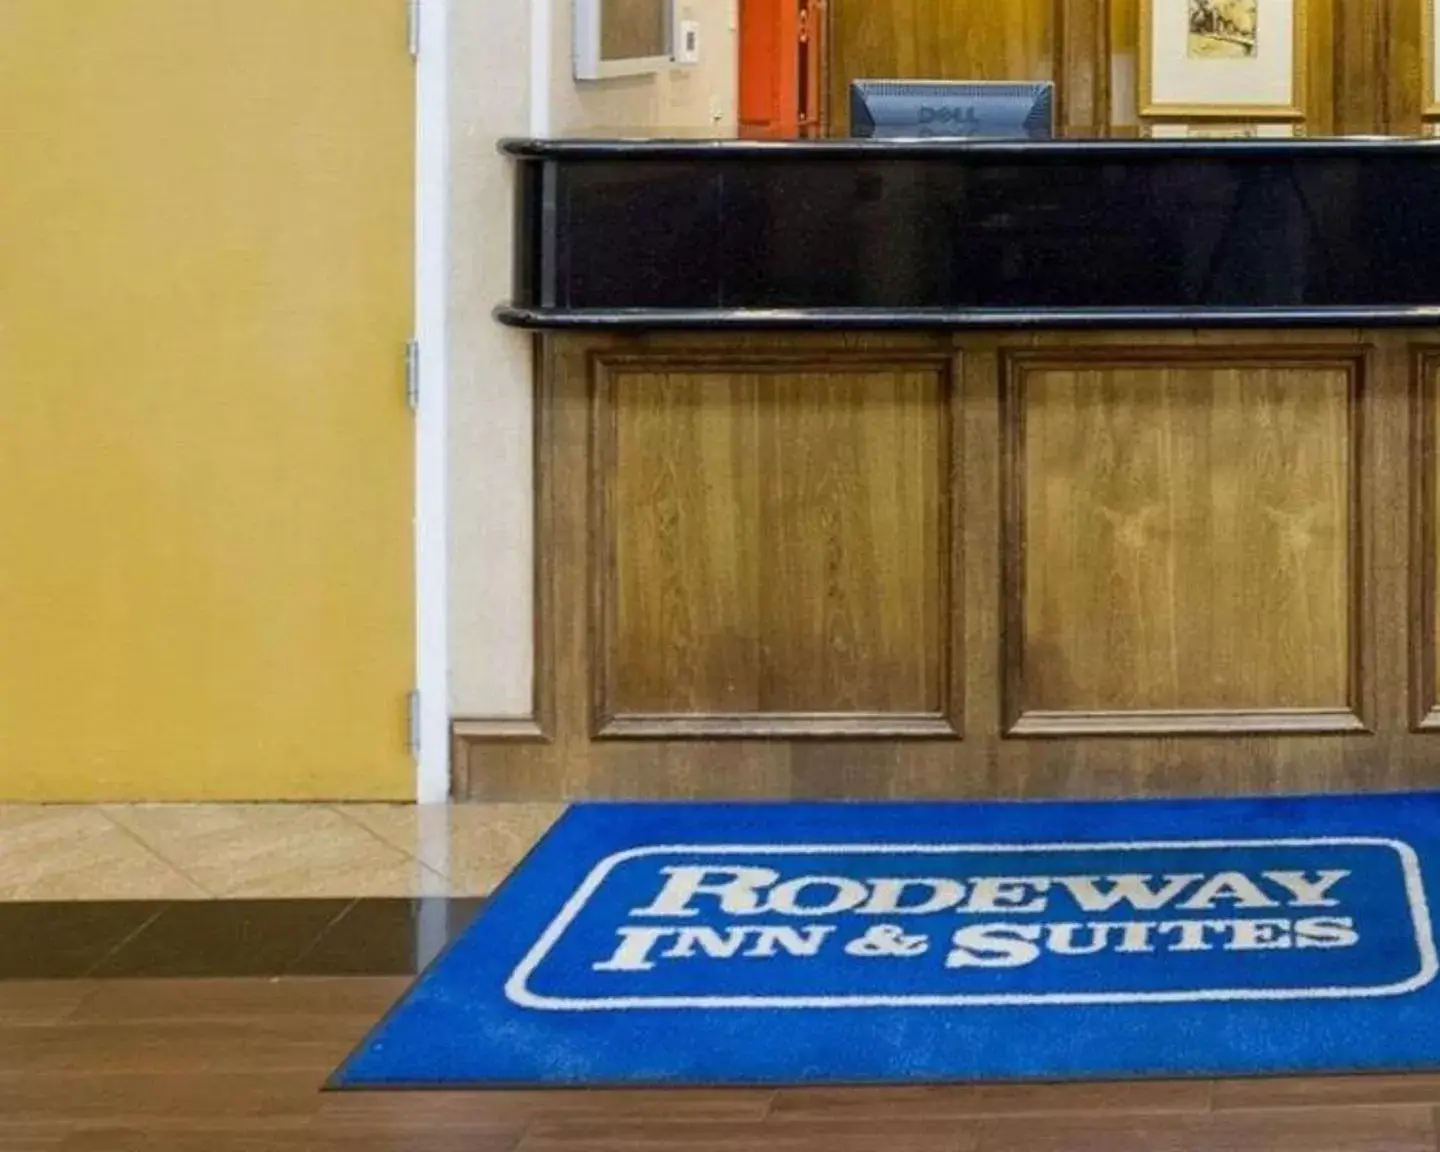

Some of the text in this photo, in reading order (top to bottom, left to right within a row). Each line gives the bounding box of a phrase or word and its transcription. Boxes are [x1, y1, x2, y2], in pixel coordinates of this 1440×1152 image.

[918, 106, 979, 124] DELL
[629, 865, 1351, 916] RODEWAY
[592, 916, 1360, 970] INN & SUITES
